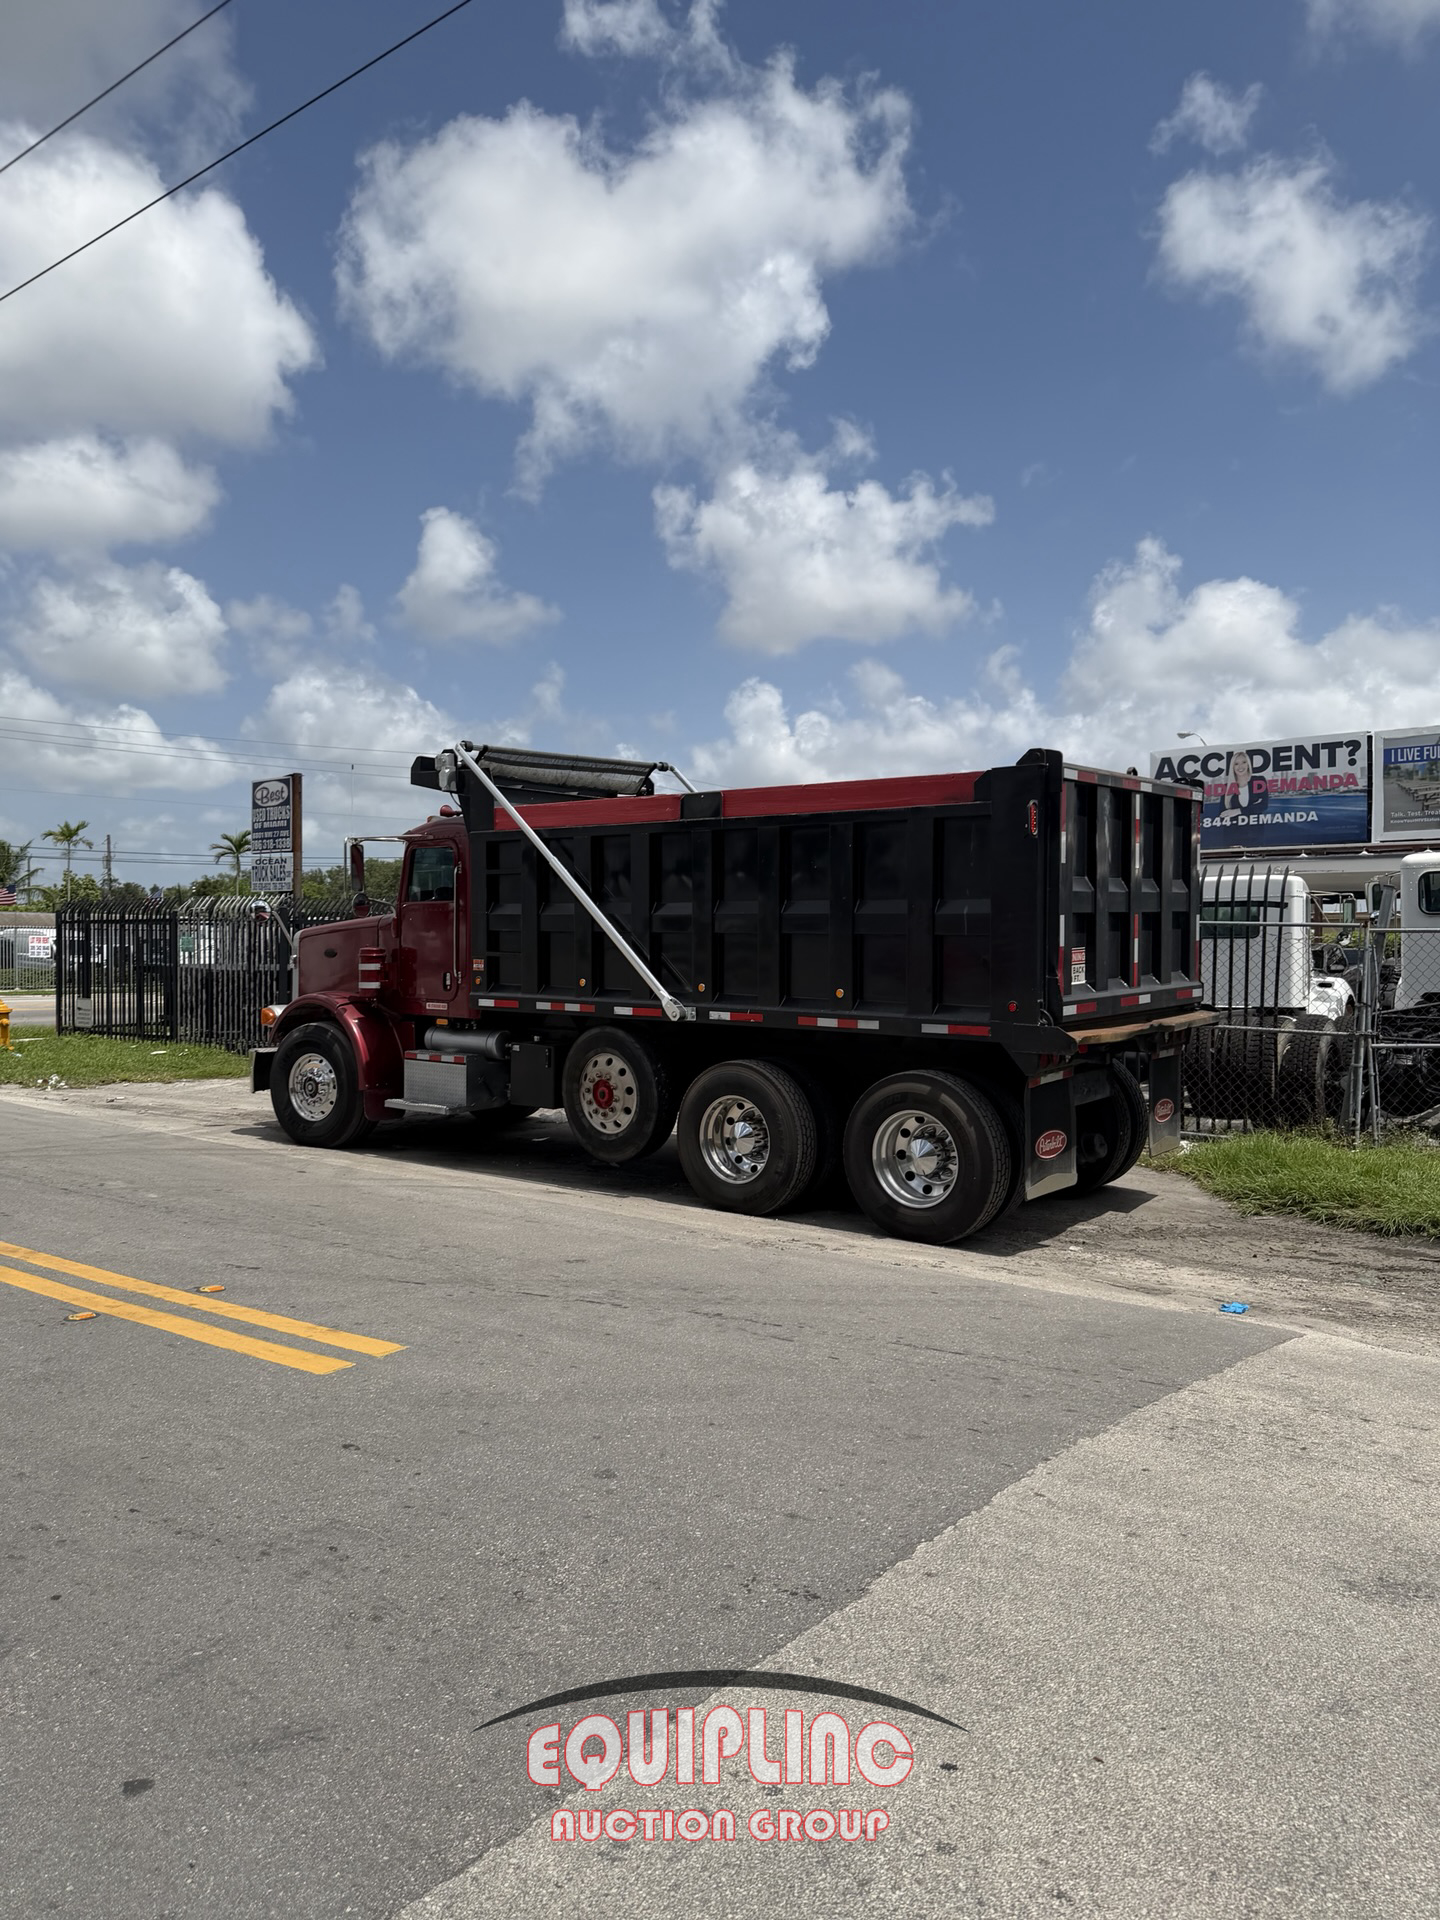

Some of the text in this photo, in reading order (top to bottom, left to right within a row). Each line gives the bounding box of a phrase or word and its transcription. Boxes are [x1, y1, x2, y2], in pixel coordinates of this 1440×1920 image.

[1155, 740, 1361, 780] ACCIDENT?
[1398, 747, 1421, 762] LIVE
[1252, 774, 1359, 794] DEMANDA
[255, 786, 285, 804] Best
[267, 806, 290, 820] TRUCKS
[252, 866, 269, 882] TRUCK
[270, 865, 286, 881] SALES
[1072, 952, 1085, 961] NING
[1073, 966, 1085, 974] BACK
